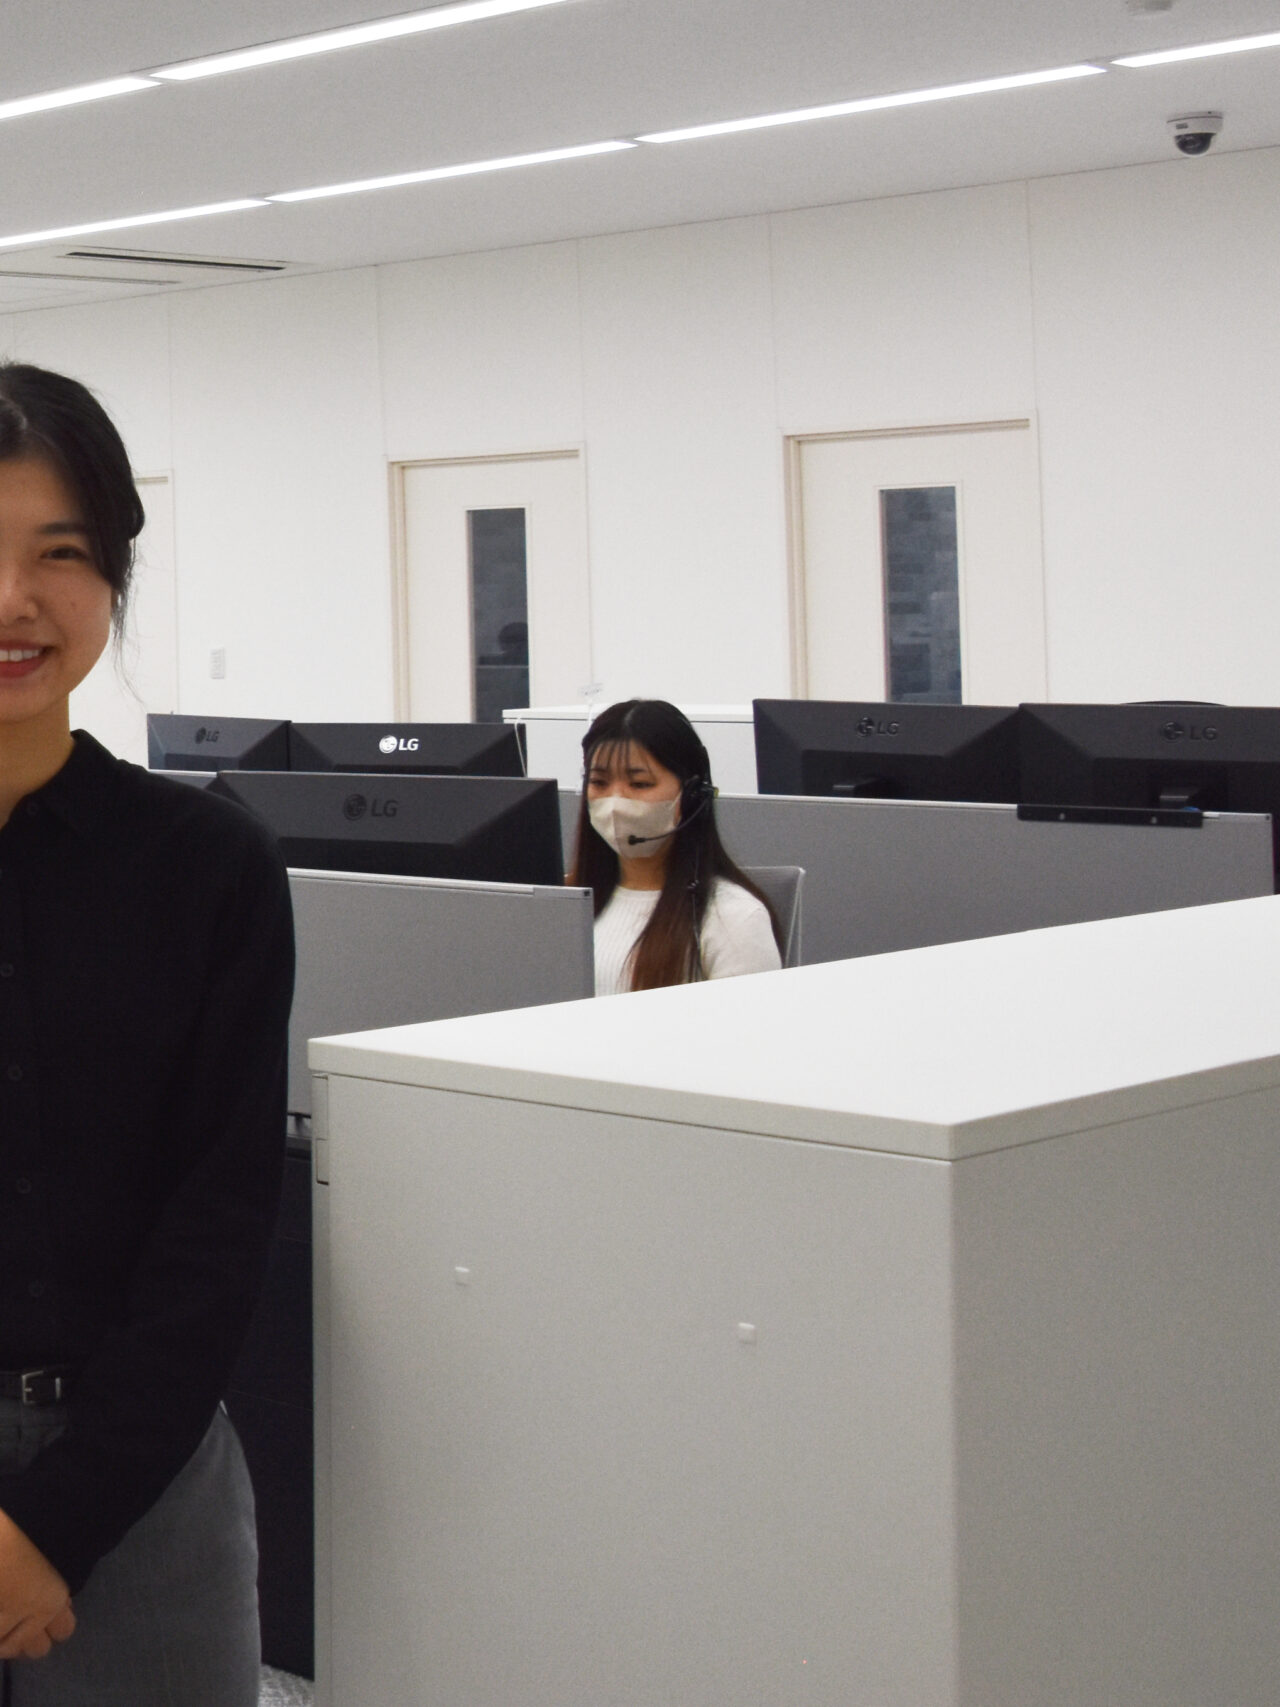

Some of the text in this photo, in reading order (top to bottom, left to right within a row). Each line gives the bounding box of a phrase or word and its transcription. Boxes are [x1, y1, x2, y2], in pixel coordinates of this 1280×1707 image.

[877, 720, 900, 735] LG
[1190, 725, 1218, 741] LG
[398, 738, 420, 751] LG
[371, 799, 399, 818] LG
